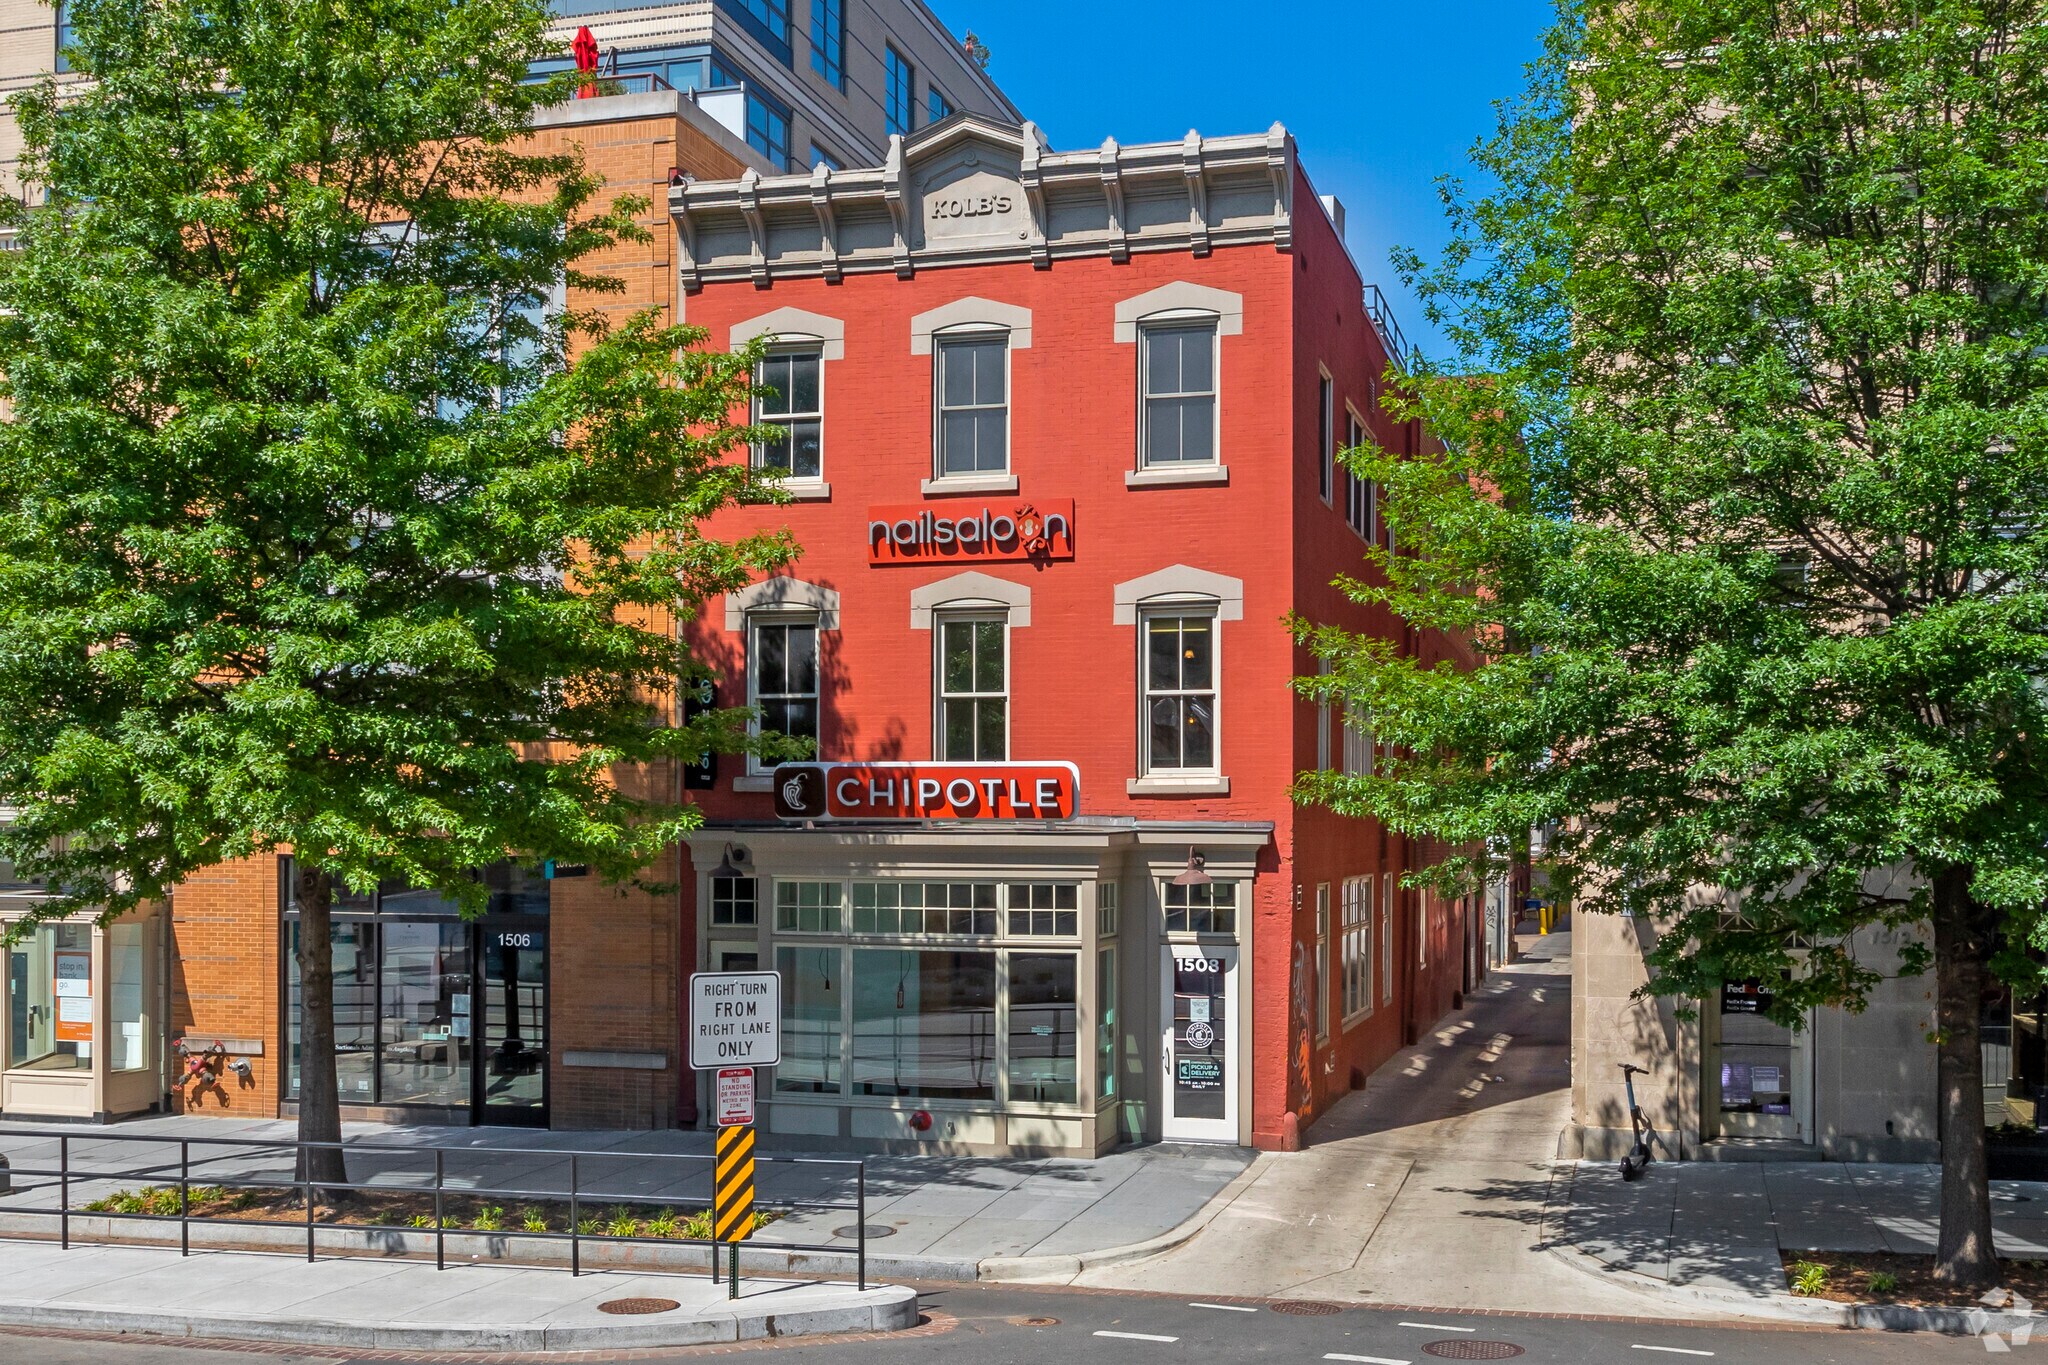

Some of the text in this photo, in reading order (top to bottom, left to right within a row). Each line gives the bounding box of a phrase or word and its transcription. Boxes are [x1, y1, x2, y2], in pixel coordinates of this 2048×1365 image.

[931, 195, 1012, 219] KOLB'S
[836, 778, 1058, 807] CHIPOTLE
[498, 933, 531, 947] 1506
[59, 962, 75, 971] stop
[1176, 958, 1220, 973] 1508
[704, 983, 767, 996] RIGHT TURN
[715, 1001, 757, 1017] FROM
[700, 1022, 771, 1036] RIGHT LANE
[718, 1041, 753, 1057] ONLY
[721, 1083, 750, 1091] STANDING
